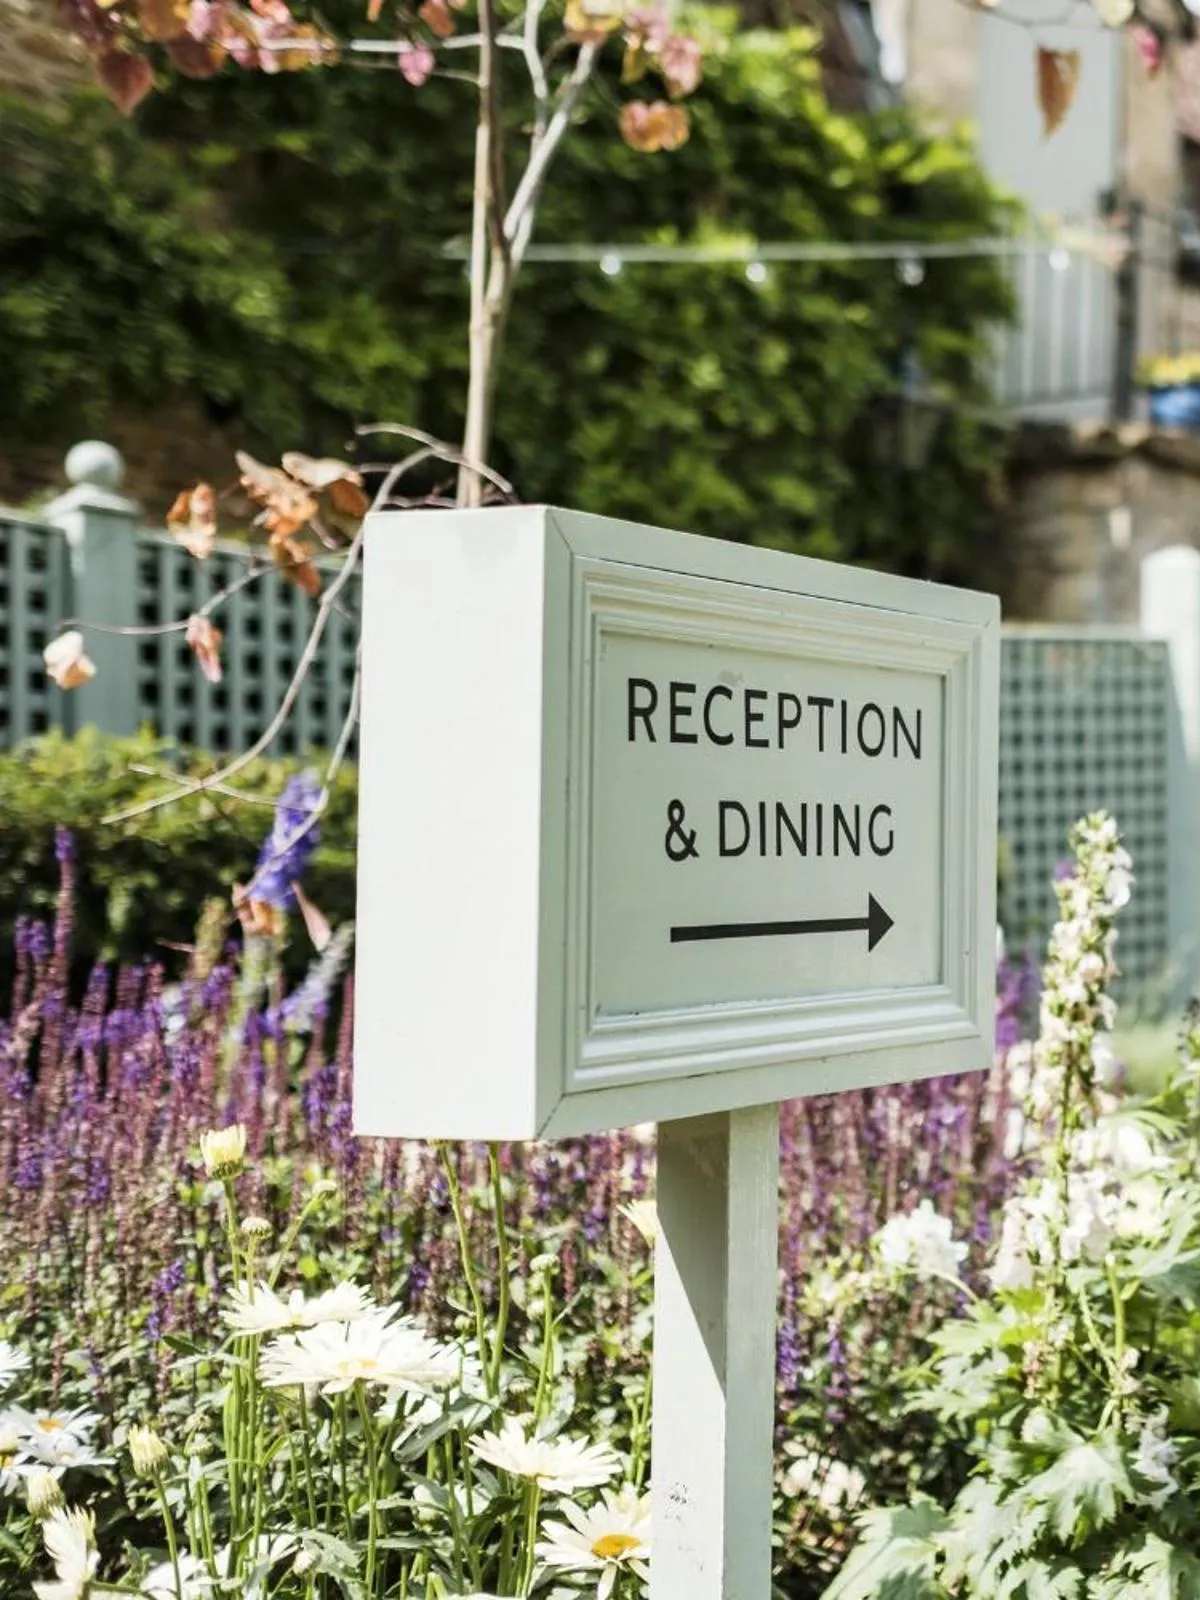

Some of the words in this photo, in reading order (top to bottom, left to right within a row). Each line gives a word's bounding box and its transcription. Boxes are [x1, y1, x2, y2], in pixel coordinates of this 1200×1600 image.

[627, 677, 923, 760] RECEPTION
[664, 798, 701, 863] &
[718, 799, 895, 858] DINING
